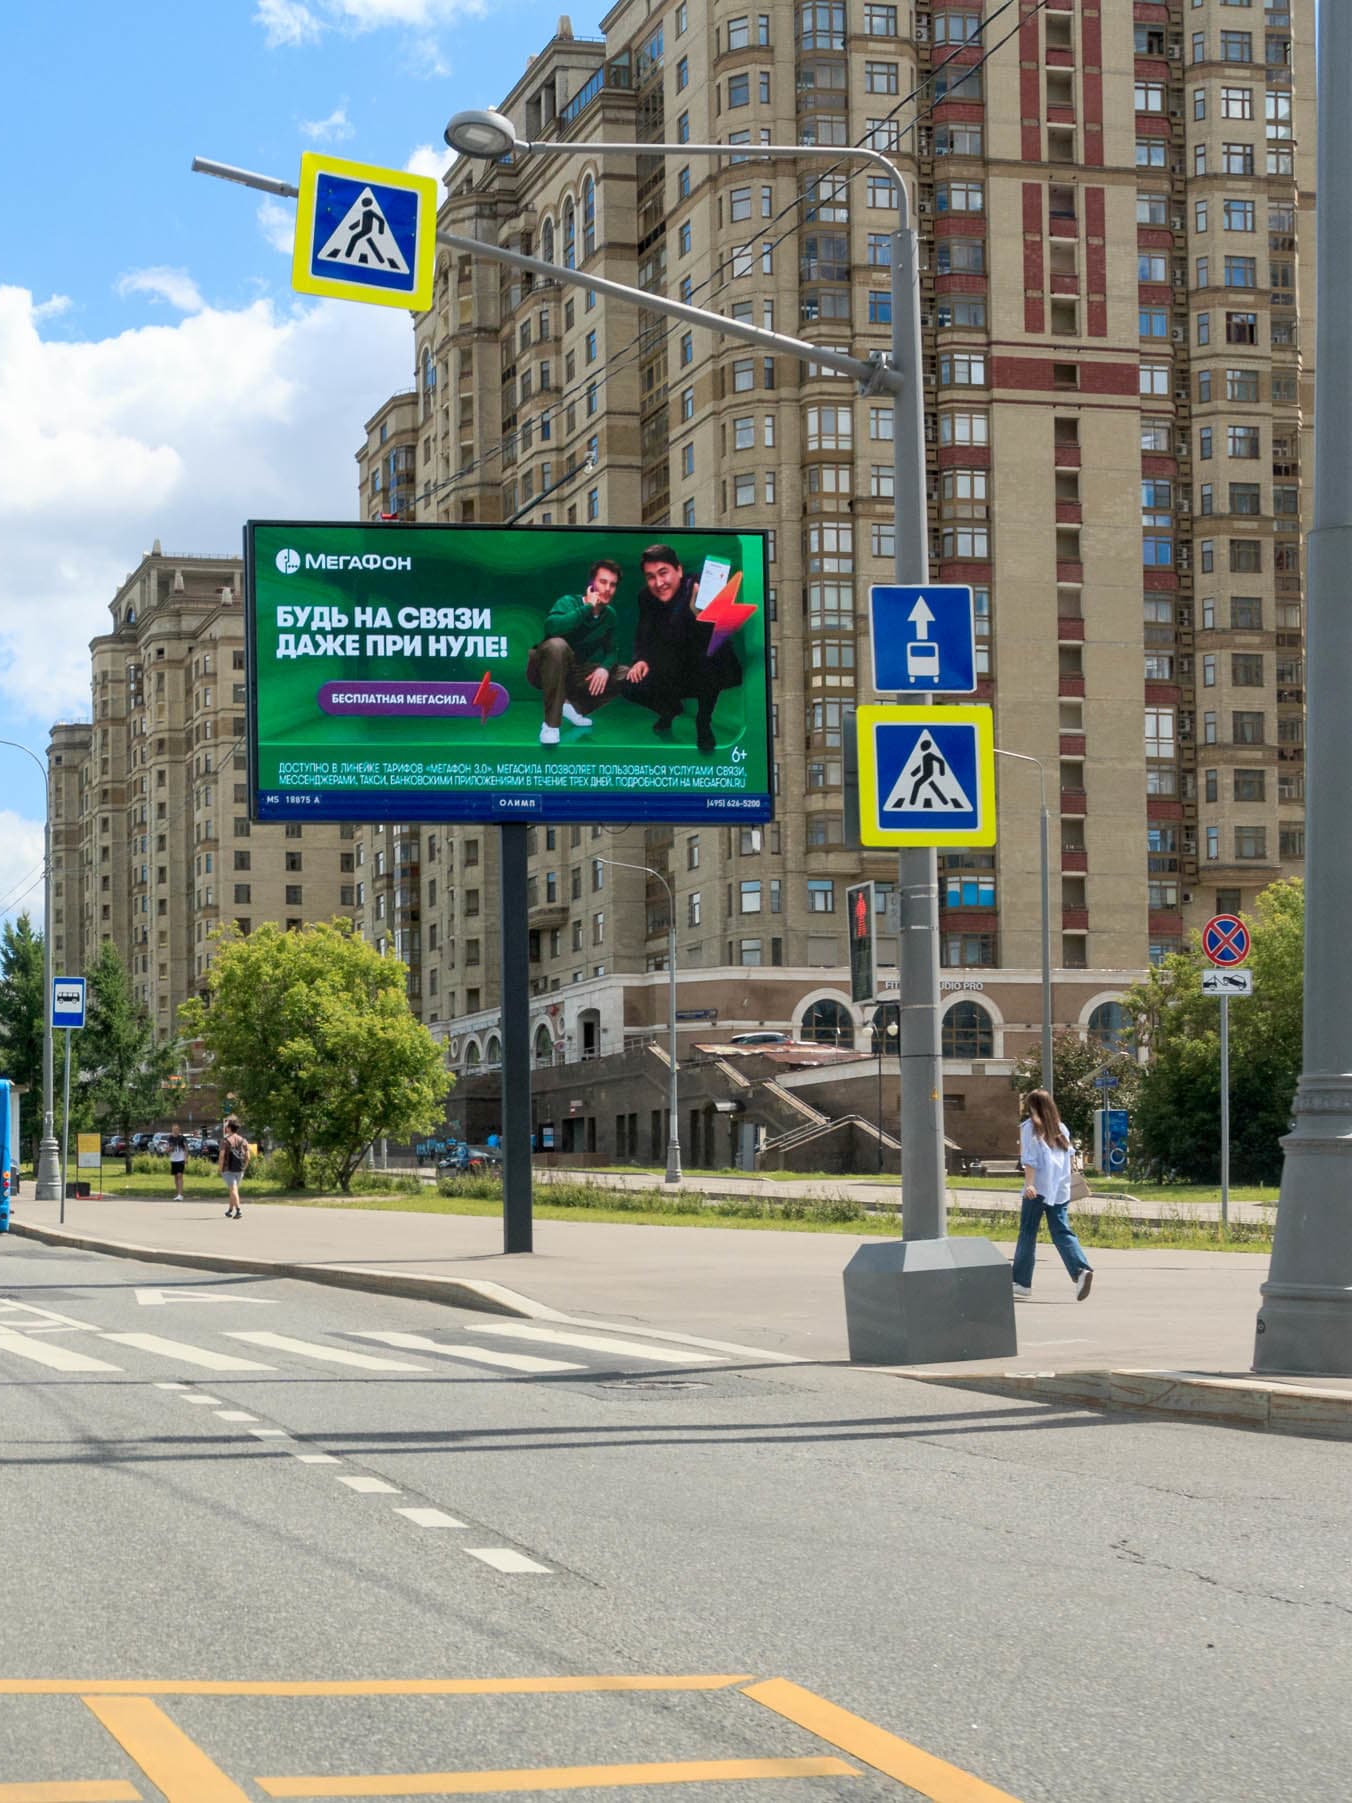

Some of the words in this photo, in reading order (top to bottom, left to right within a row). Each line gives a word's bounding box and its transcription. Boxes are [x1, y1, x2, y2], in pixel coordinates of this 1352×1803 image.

[276, 605, 349, 631] БУДЬ
[354, 606, 393, 629] НА
[397, 606, 492, 630] СВЯЗИ
[276, 633, 360, 659] ДАЖЕ
[366, 634, 422, 657] ПРИ
[428, 635, 508, 658] НУЛЕ!
[331, 693, 404, 704] БЕСПЛАТНАЯ
[406, 694, 467, 705] МЕГАСИЛА
[731, 746, 748, 763] 6+
[278, 762, 329, 774] ДОСТУПНО
[331, 763, 338, 773] В
[340, 761, 380, 773] ЛИНЕЙКЕ
[382, 763, 424, 773] ТАРИФОВ
[425, 763, 472, 774] «МЕГАФОН
[497, 763, 542, 774] МЕГАСИЛА
[544, 764, 597, 775] ПОЗВОЛЯЕТ
[599, 765, 667, 776] ПОЛЬЗОВАТЬСЯ
[668, 765, 714, 776] УСЛУГАМИ
[390, 775, 453, 786] БАНКОВСКИМИ
[454, 776, 525, 786] ПРИЛОЖЕНИЯМИ
[526, 776, 533, 785] В
[534, 776, 568, 786] ТЕЧЕНИЕ
[569, 776, 589, 786] ТРЕХ
[615, 777, 678, 788] ПОДРОБНОСТИ
[680, 777, 691, 787] НА
[692, 777, 746, 788] MEGAFON.RU
[499, 799, 536, 807] ОЛИМП
[963, 981, 984, 991] PRO
